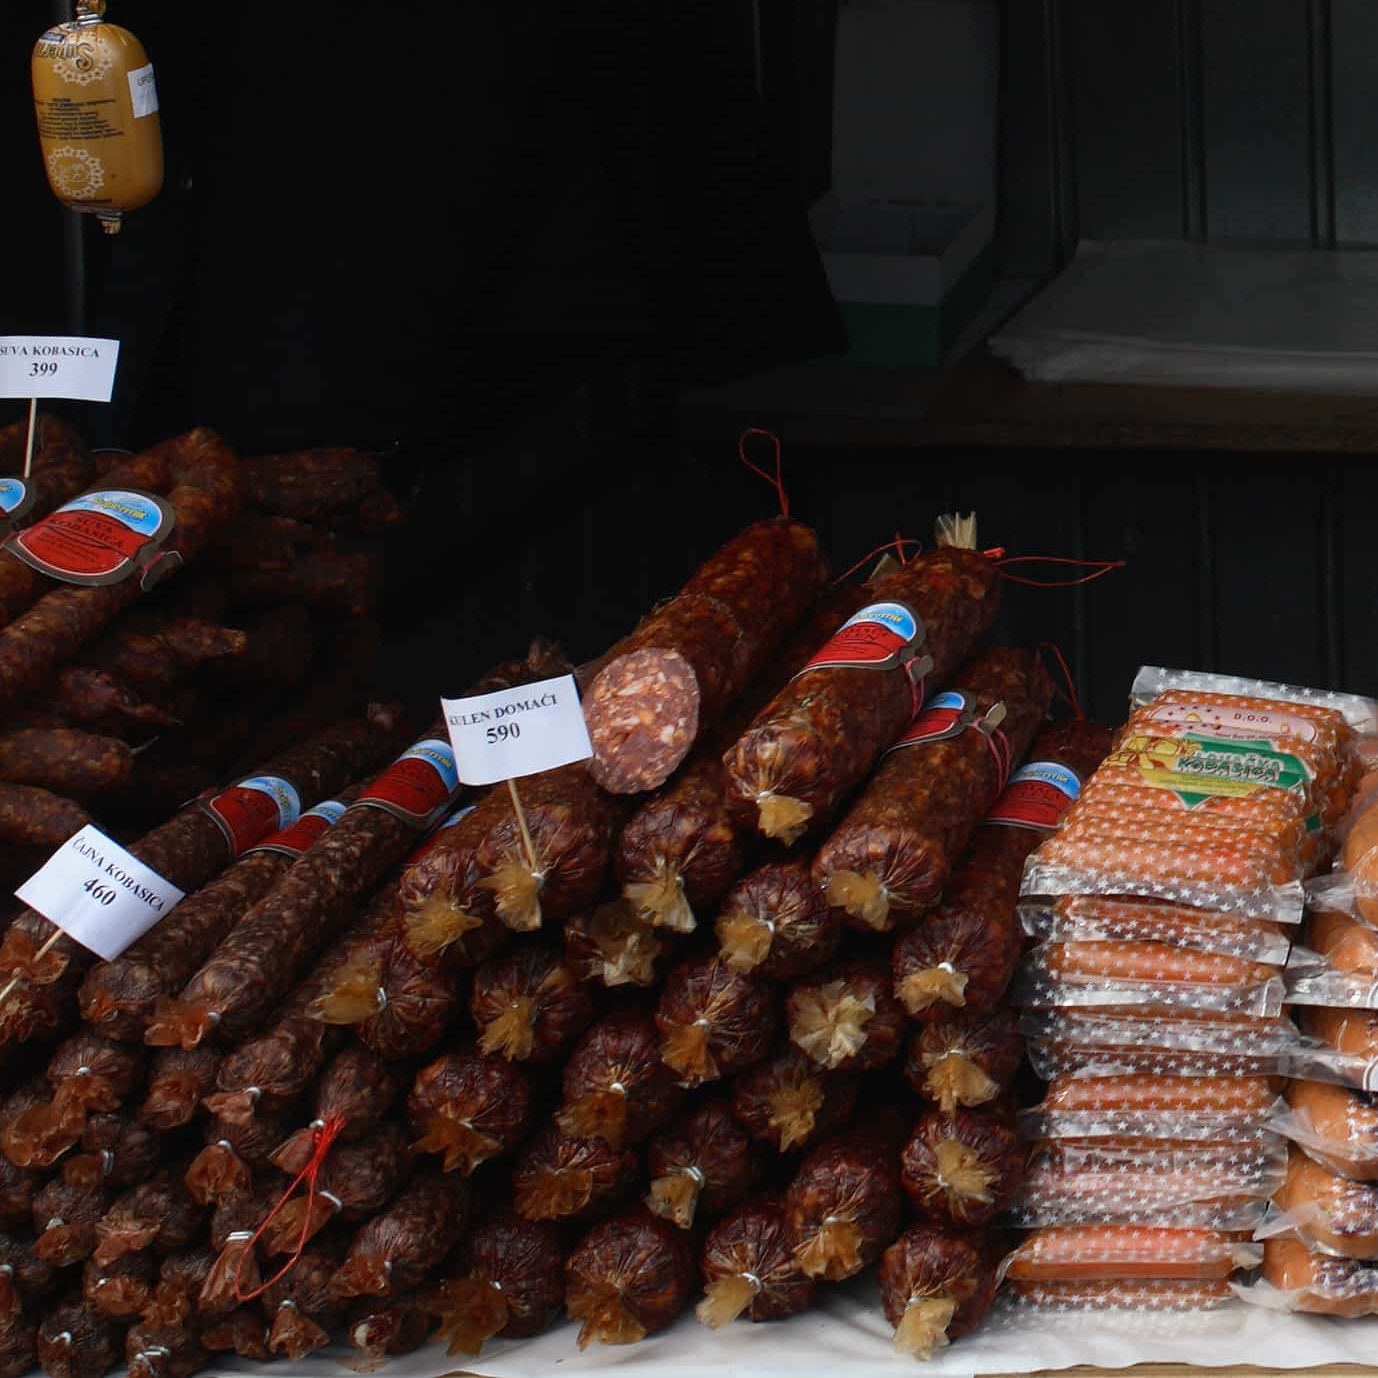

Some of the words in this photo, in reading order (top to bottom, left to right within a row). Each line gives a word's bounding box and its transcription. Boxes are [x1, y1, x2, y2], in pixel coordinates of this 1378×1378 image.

[32, 345, 100, 359] KOBASICA
[29, 362, 59, 377] 399
[1233, 711, 1273, 723] D.O.O.
[485, 721, 522, 745] 590
[72, 835, 105, 868] ČAJNA
[104, 862, 166, 913] KOBASICA
[83, 876, 118, 907] 460
